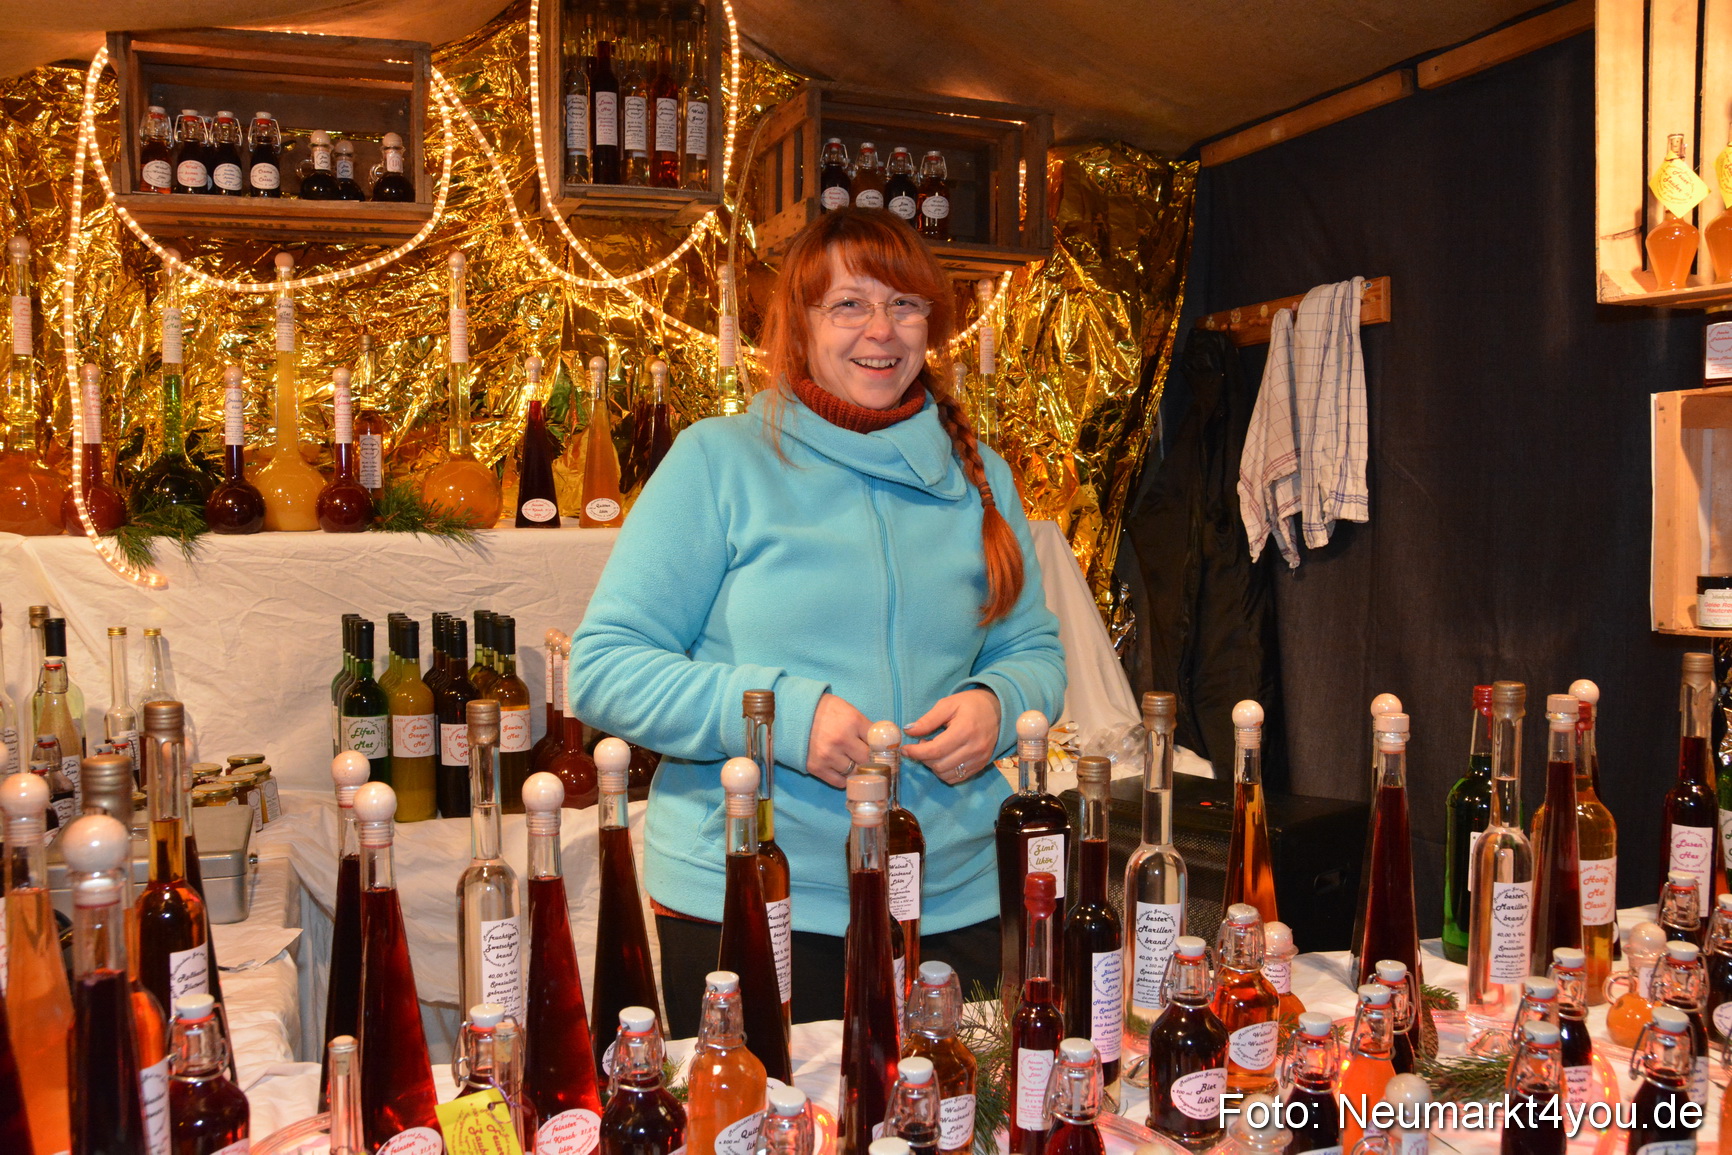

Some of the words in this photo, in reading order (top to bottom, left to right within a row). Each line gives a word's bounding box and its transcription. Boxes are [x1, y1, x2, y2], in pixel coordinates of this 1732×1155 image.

[350, 728, 376, 739] Elfen
[354, 741, 374, 750] Met
[1676, 839, 1702, 848] Lusen
[1034, 844, 1054, 856] Zimt
[1680, 852, 1699, 860] Hex
[1146, 914, 1168, 922] bester
[1145, 937, 1168, 946] brand
[496, 951, 513, 960] brand
[1196, 1083, 1216, 1094] Bier
[552, 1122, 577, 1136] feinster
[946, 1124, 964, 1135] Likör
